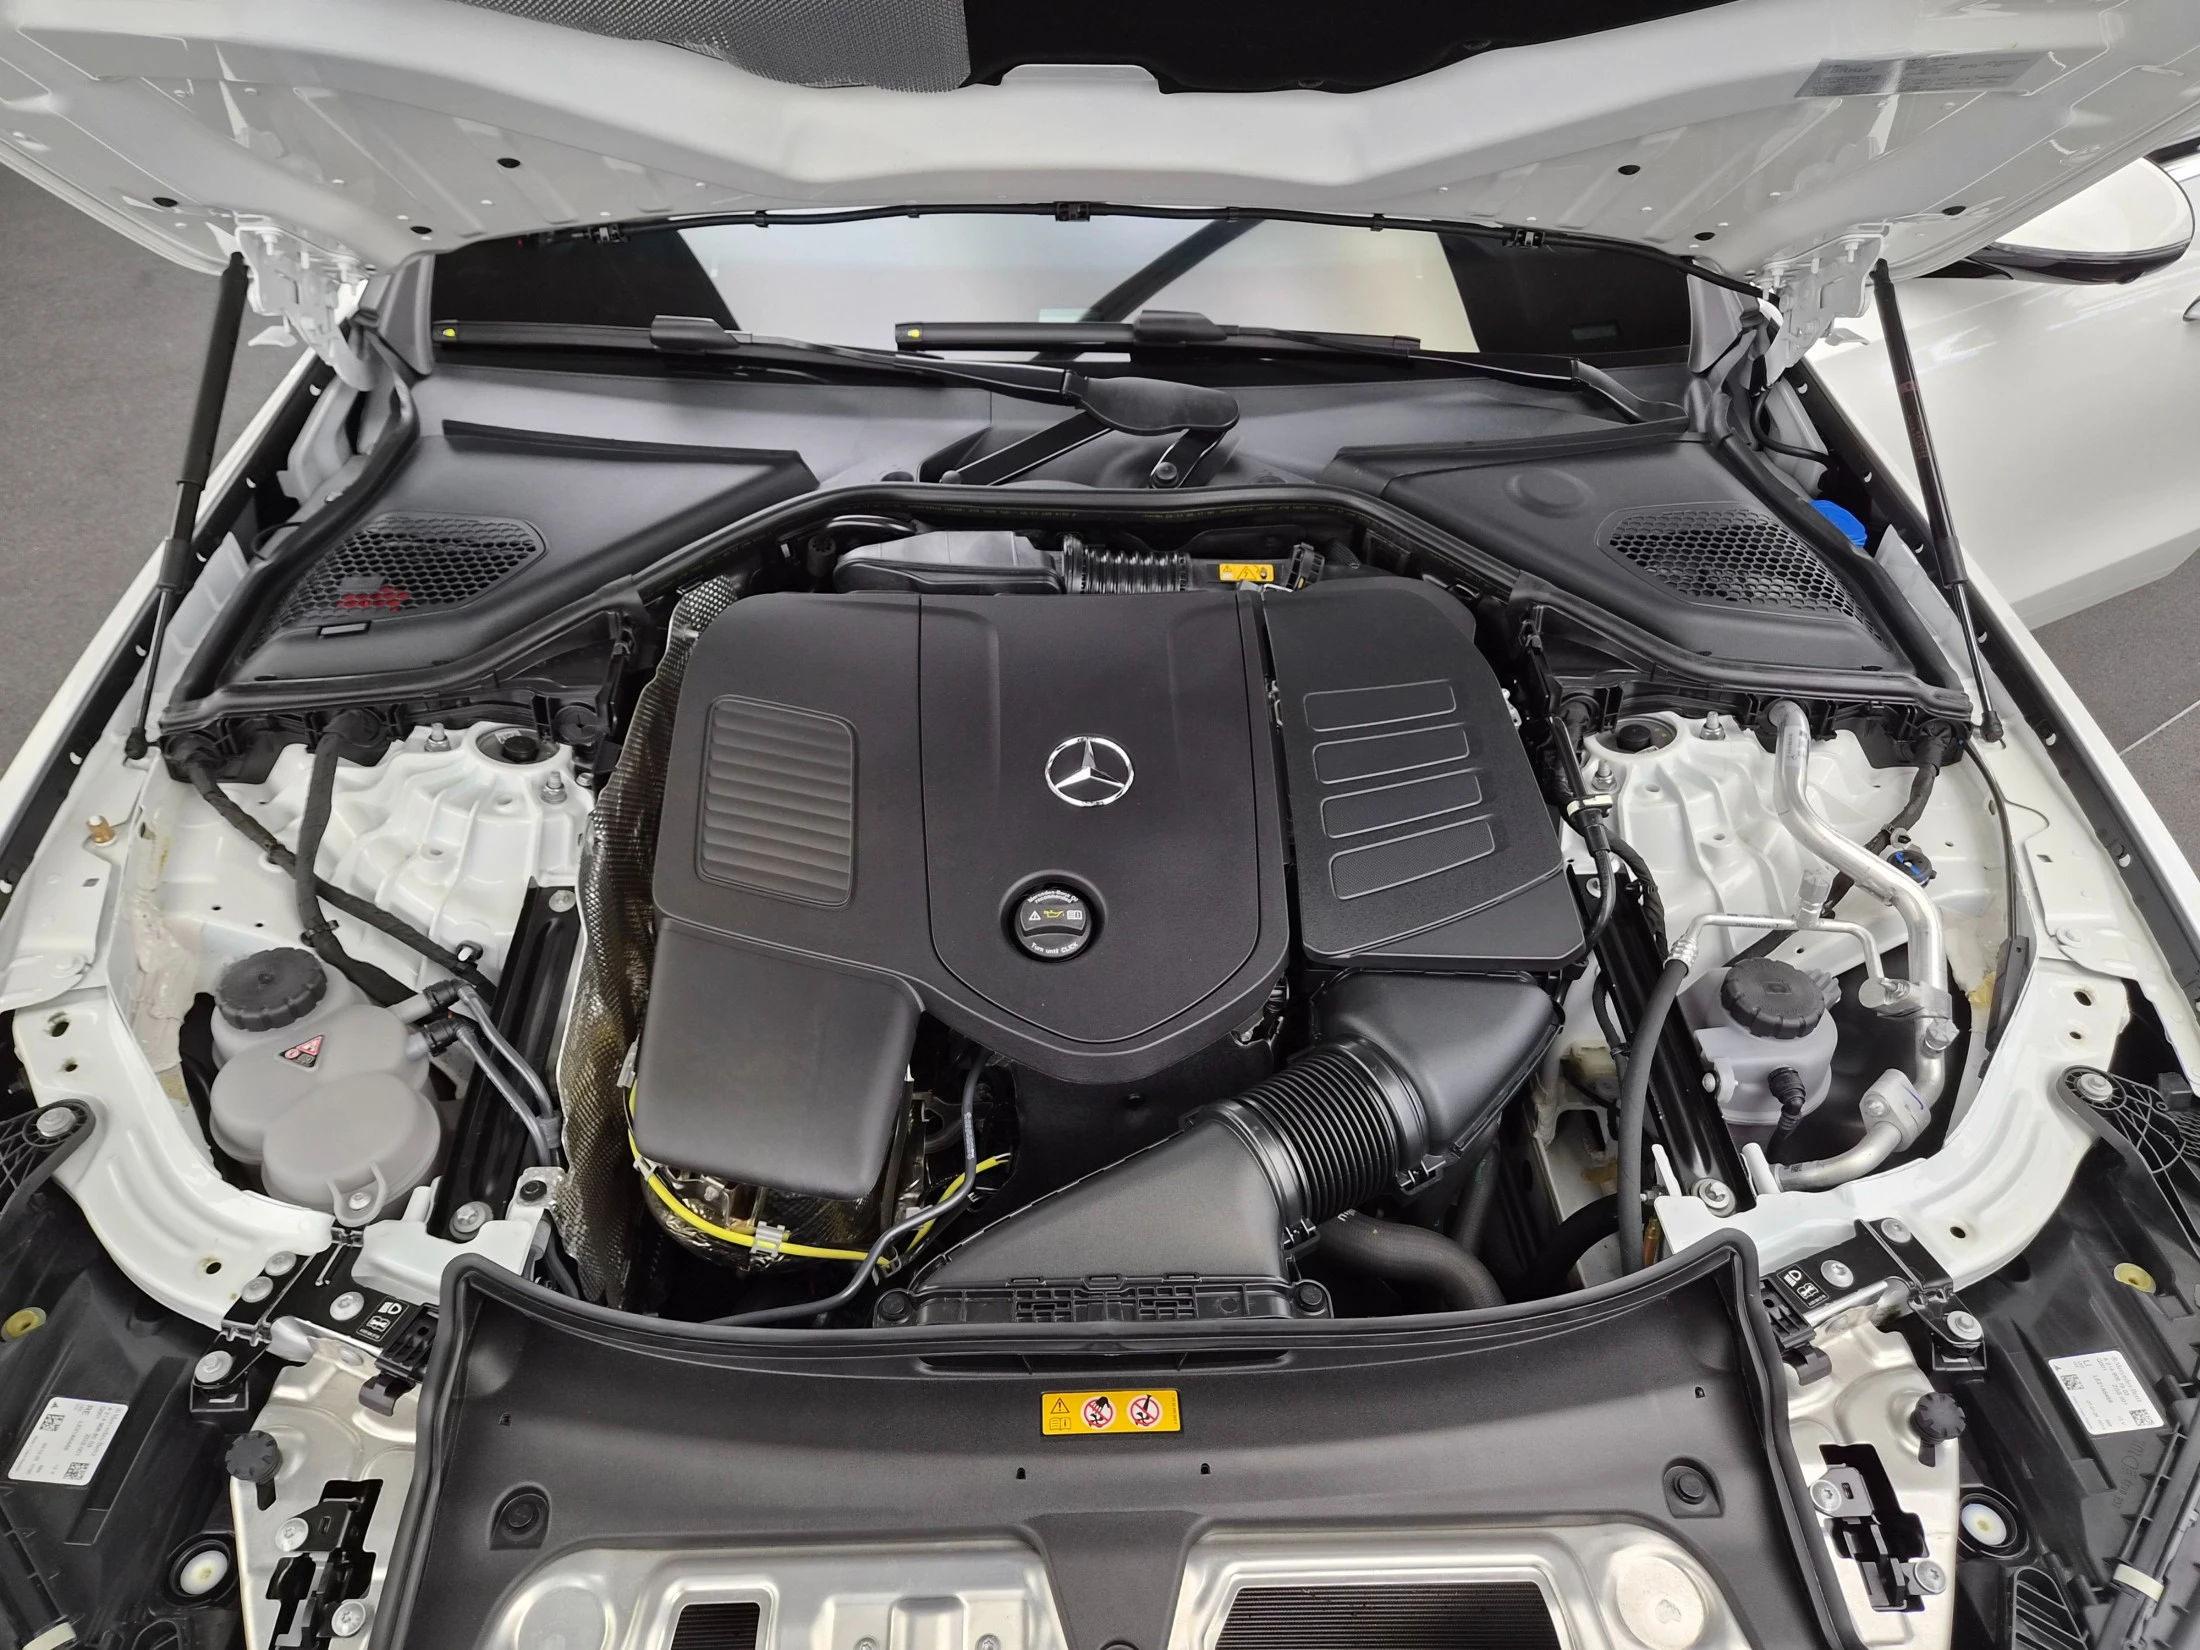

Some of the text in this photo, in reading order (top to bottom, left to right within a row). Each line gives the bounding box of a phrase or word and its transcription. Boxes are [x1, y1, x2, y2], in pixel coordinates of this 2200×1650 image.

[1027, 890, 1071, 903] Mercedes-Benz
[1031, 942, 1044, 952] Turn
[1060, 941, 1079, 953] CLICK
